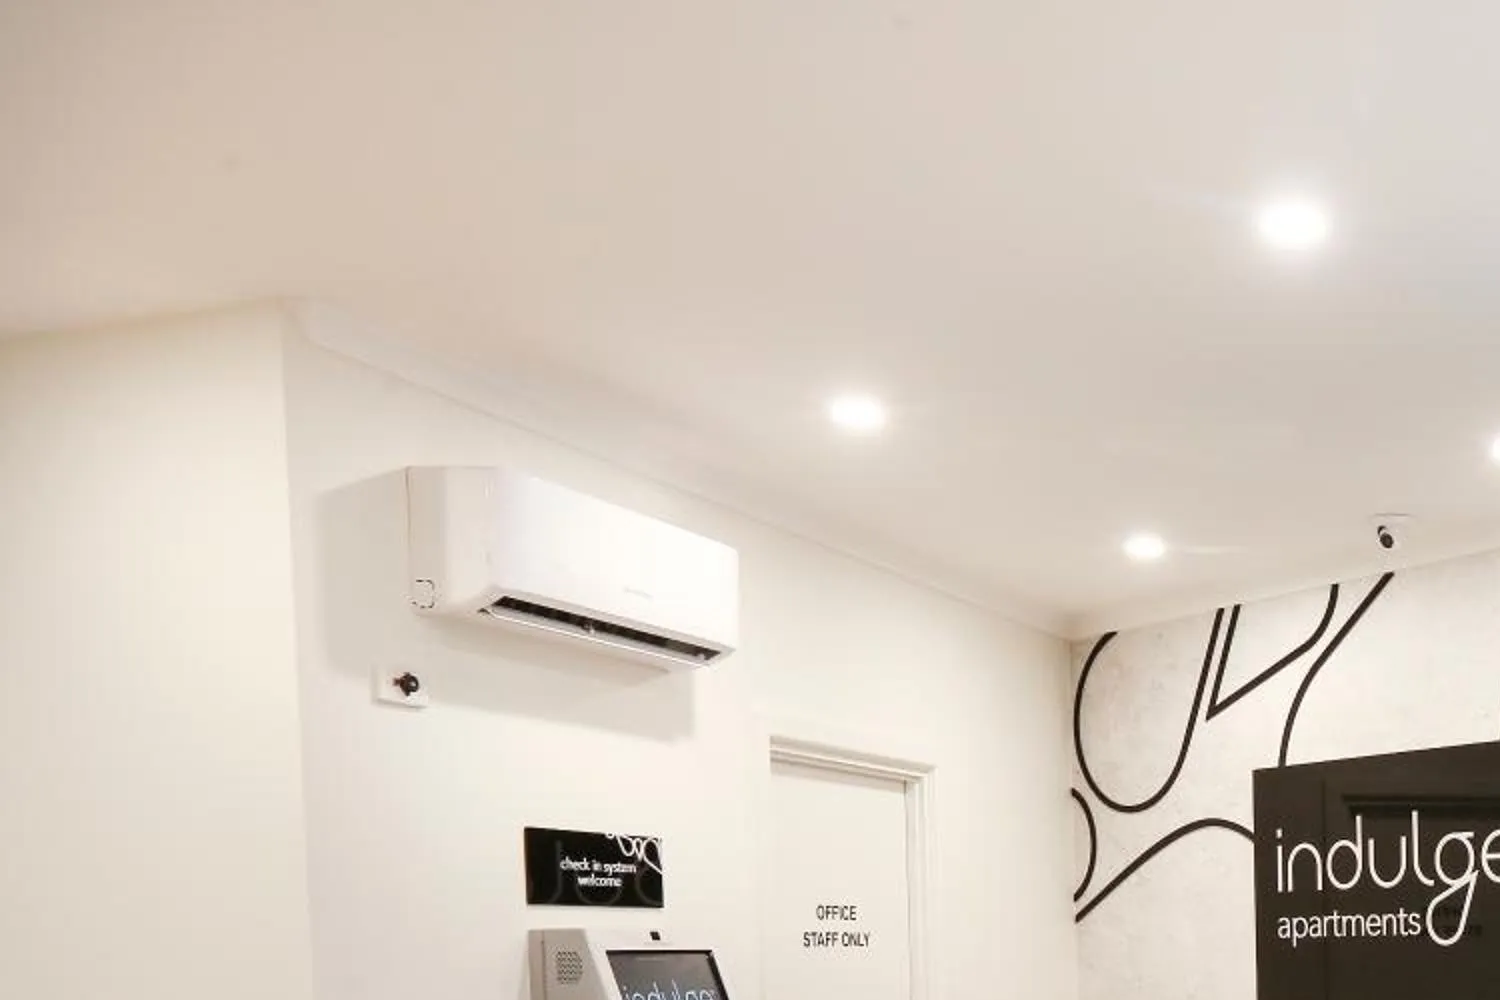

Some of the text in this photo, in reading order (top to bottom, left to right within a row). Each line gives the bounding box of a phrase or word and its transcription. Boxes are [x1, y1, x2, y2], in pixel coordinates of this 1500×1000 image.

[560, 856, 637, 876] check in system
[578, 873, 622, 887] welcome
[815, 904, 857, 920] OFFICE
[1277, 908, 1422, 948] apartments
[803, 931, 870, 947] STAFF ONLY
